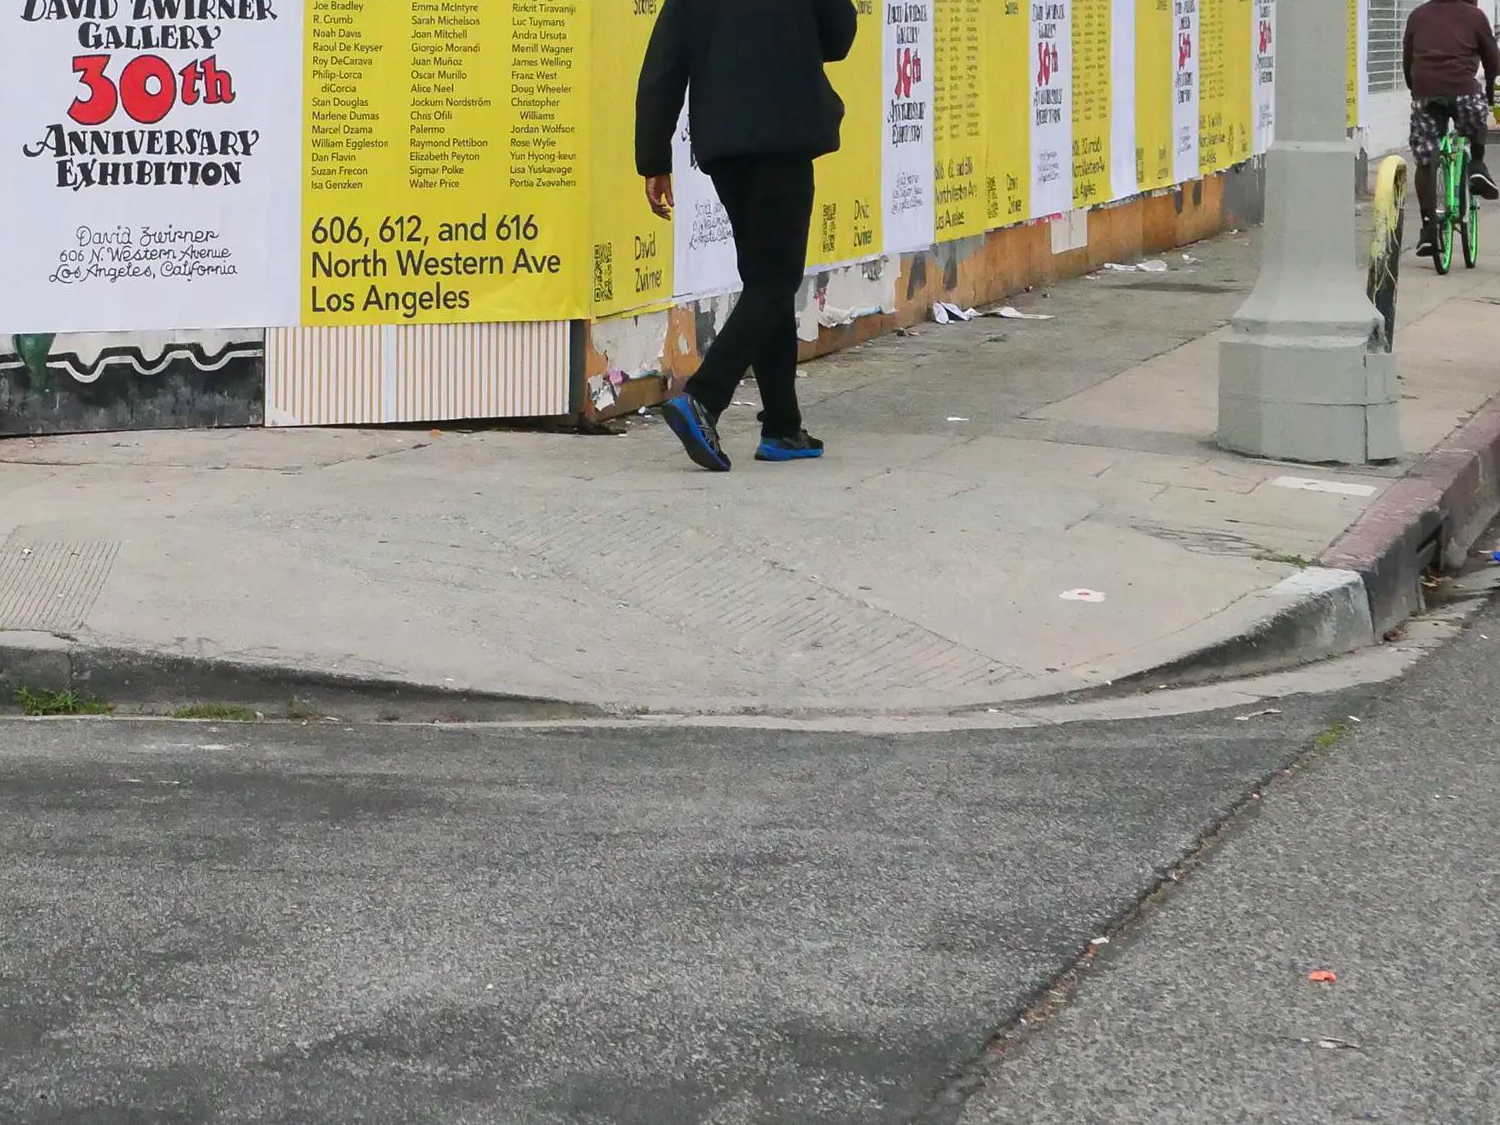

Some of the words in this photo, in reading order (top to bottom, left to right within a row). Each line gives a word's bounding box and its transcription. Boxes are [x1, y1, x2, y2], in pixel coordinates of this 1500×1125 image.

[78, 22, 221, 50] GALLERY
[512, 18, 526, 26] Luc
[530, 17, 565, 27] Tuymans
[67, 54, 236, 125] 30th
[23, 124, 259, 157] ANNIVERSARY
[56, 158, 241, 191] EXHIBITION
[77, 226, 132, 247] David
[141, 227, 218, 246] Zwirner
[312, 217, 369, 247] 606,
[379, 215, 429, 246] 612,
[438, 213, 486, 241] and
[496, 214, 538, 241] 616
[59, 249, 83, 263] 606
[107, 248, 176, 262] Western
[180, 248, 231, 262] Avenue
[635, 231, 656, 260] David
[49, 263, 79, 283] Los
[83, 263, 156, 283] Angeles,
[161, 262, 237, 281] California
[312, 249, 386, 278] North
[396, 250, 503, 276] Western
[512, 248, 560, 273] Ave
[312, 286, 354, 312] Los
[363, 282, 469, 318] Angeles
